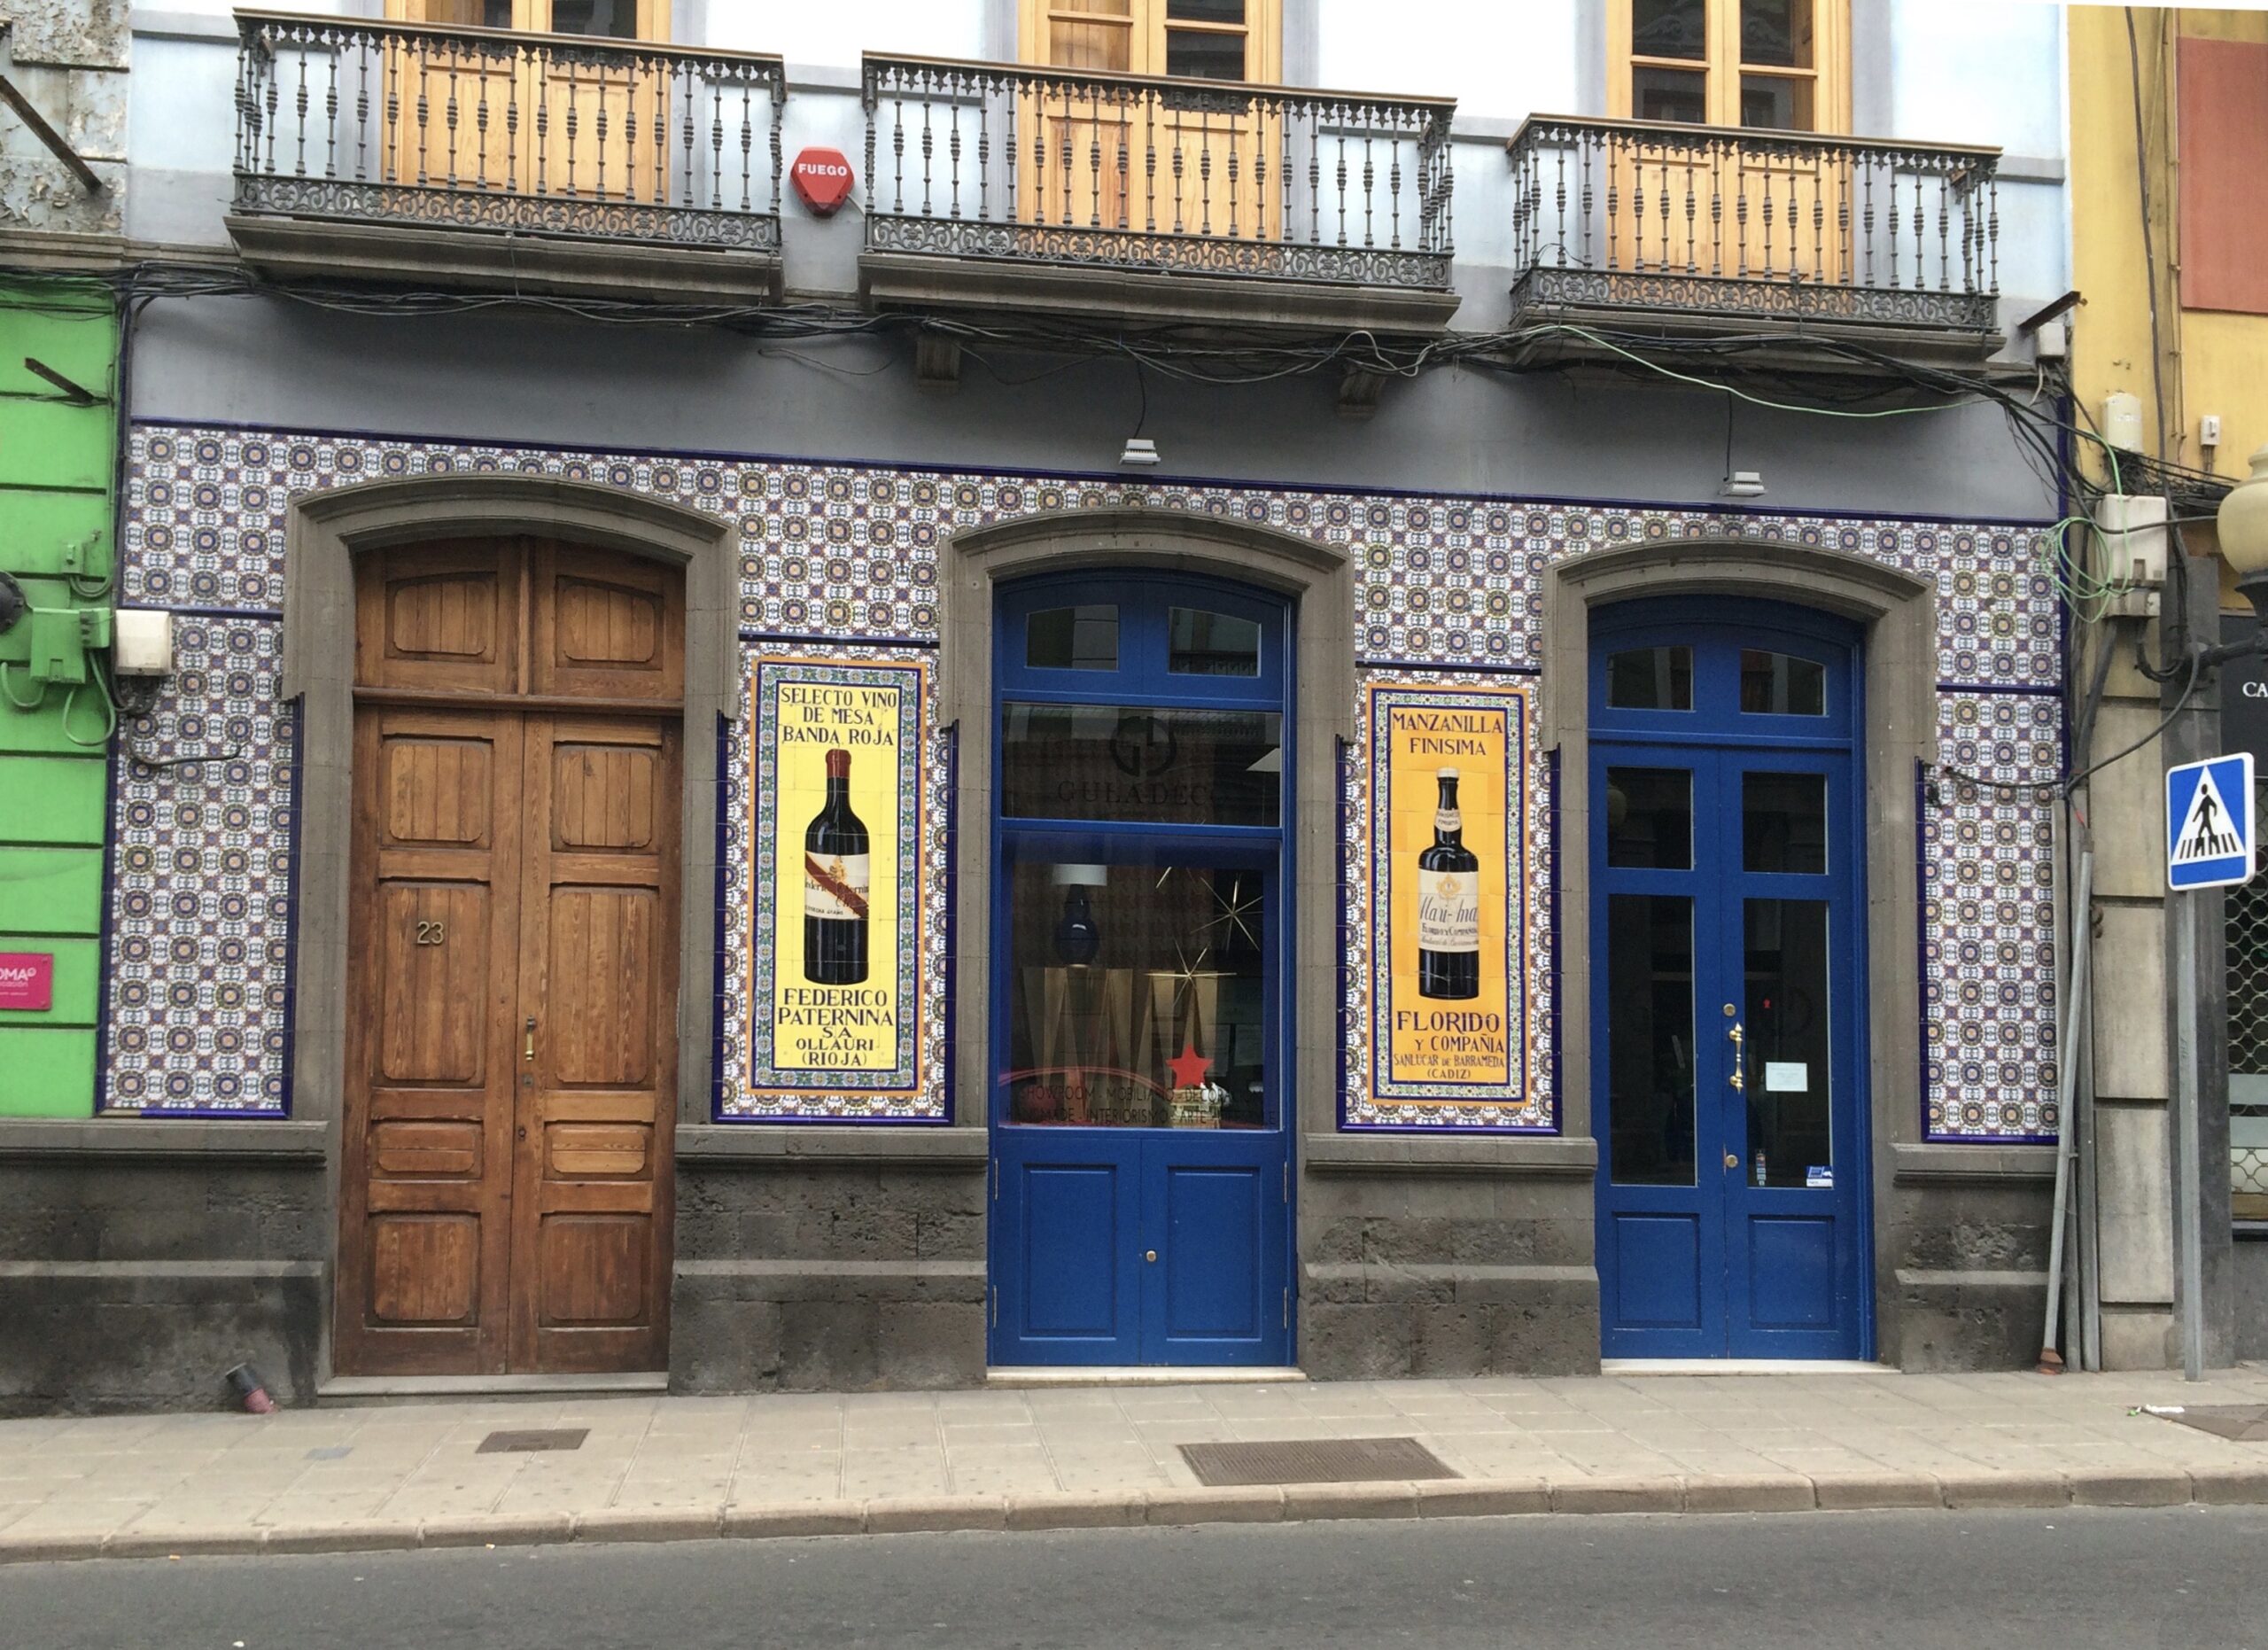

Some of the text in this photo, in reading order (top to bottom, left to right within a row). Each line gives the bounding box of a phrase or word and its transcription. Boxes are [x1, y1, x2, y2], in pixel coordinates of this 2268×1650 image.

[798, 163, 848, 176] FUEGO
[781, 687, 897, 708] SELECTO VINO
[2242, 681, 2268, 697] CA
[803, 706, 874, 725] DE MESA
[1393, 712, 1503, 734] MANZANILLA
[783, 726, 894, 746] BANDA ROJA
[1410, 737, 1487, 755] FINISIMA
[1058, 780, 1225, 807] GULADEC
[417, 921, 444, 945] 23
[784, 988, 888, 1007] FEDERICO
[778, 1007, 894, 1026] PATERNINA
[1396, 1010, 1500, 1034] FLORIDO
[796, 1038, 874, 1051] OLLAURI
[1415, 1033, 1504, 1053] Y COMPAÑIA
[802, 1051, 867, 1066] (RIOJA)
[1454, 1055, 1504, 1068] BARRAMEDA
[1427, 1068, 1472, 1079] (CADIZ)
[1107, 1086, 1174, 1102] MOBILIAO
[1006, 1107, 1075, 1123] HNDMADE
